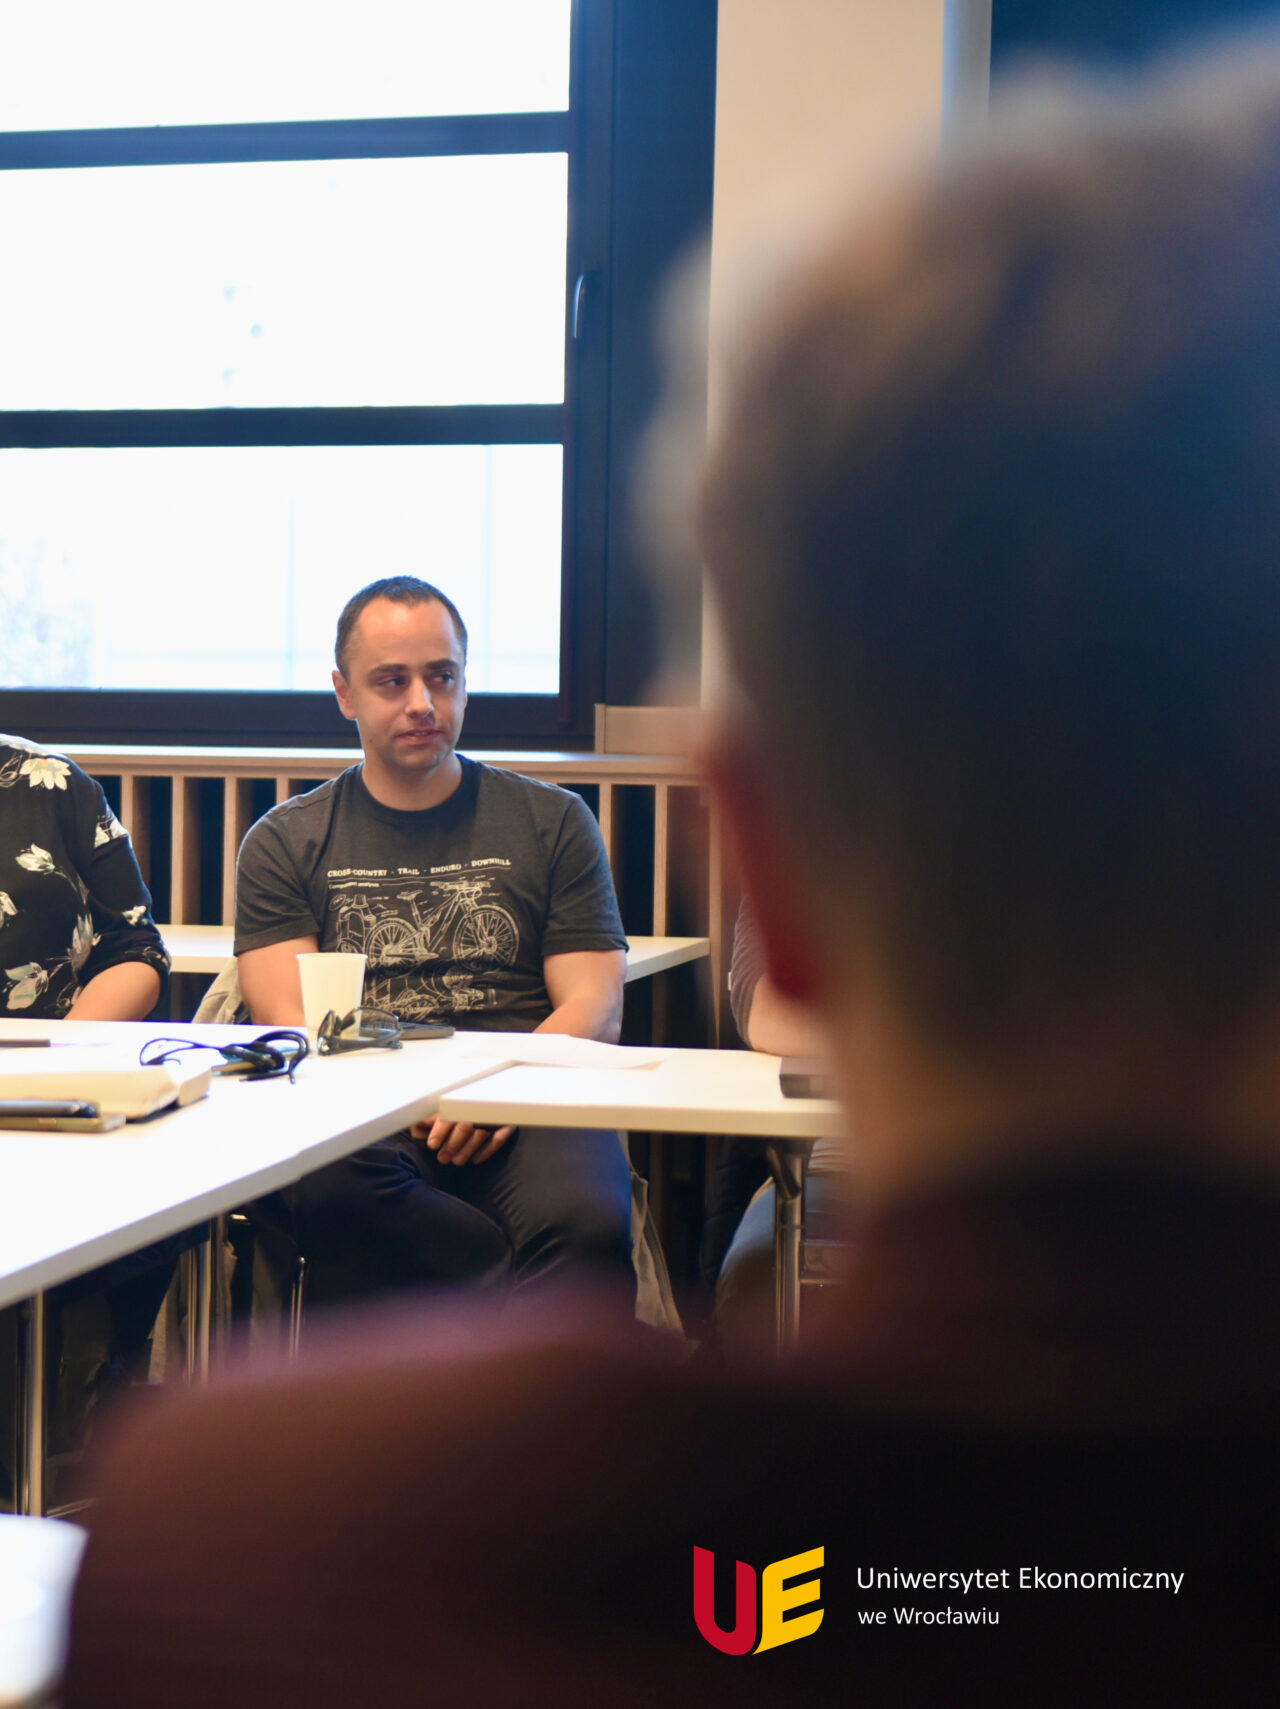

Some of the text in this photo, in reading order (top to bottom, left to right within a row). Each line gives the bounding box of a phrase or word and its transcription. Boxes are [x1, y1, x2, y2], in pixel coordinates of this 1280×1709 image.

[327, 858, 512, 877] CROSS-COUNTRY TRAIL ENDURO DOWNHILL
